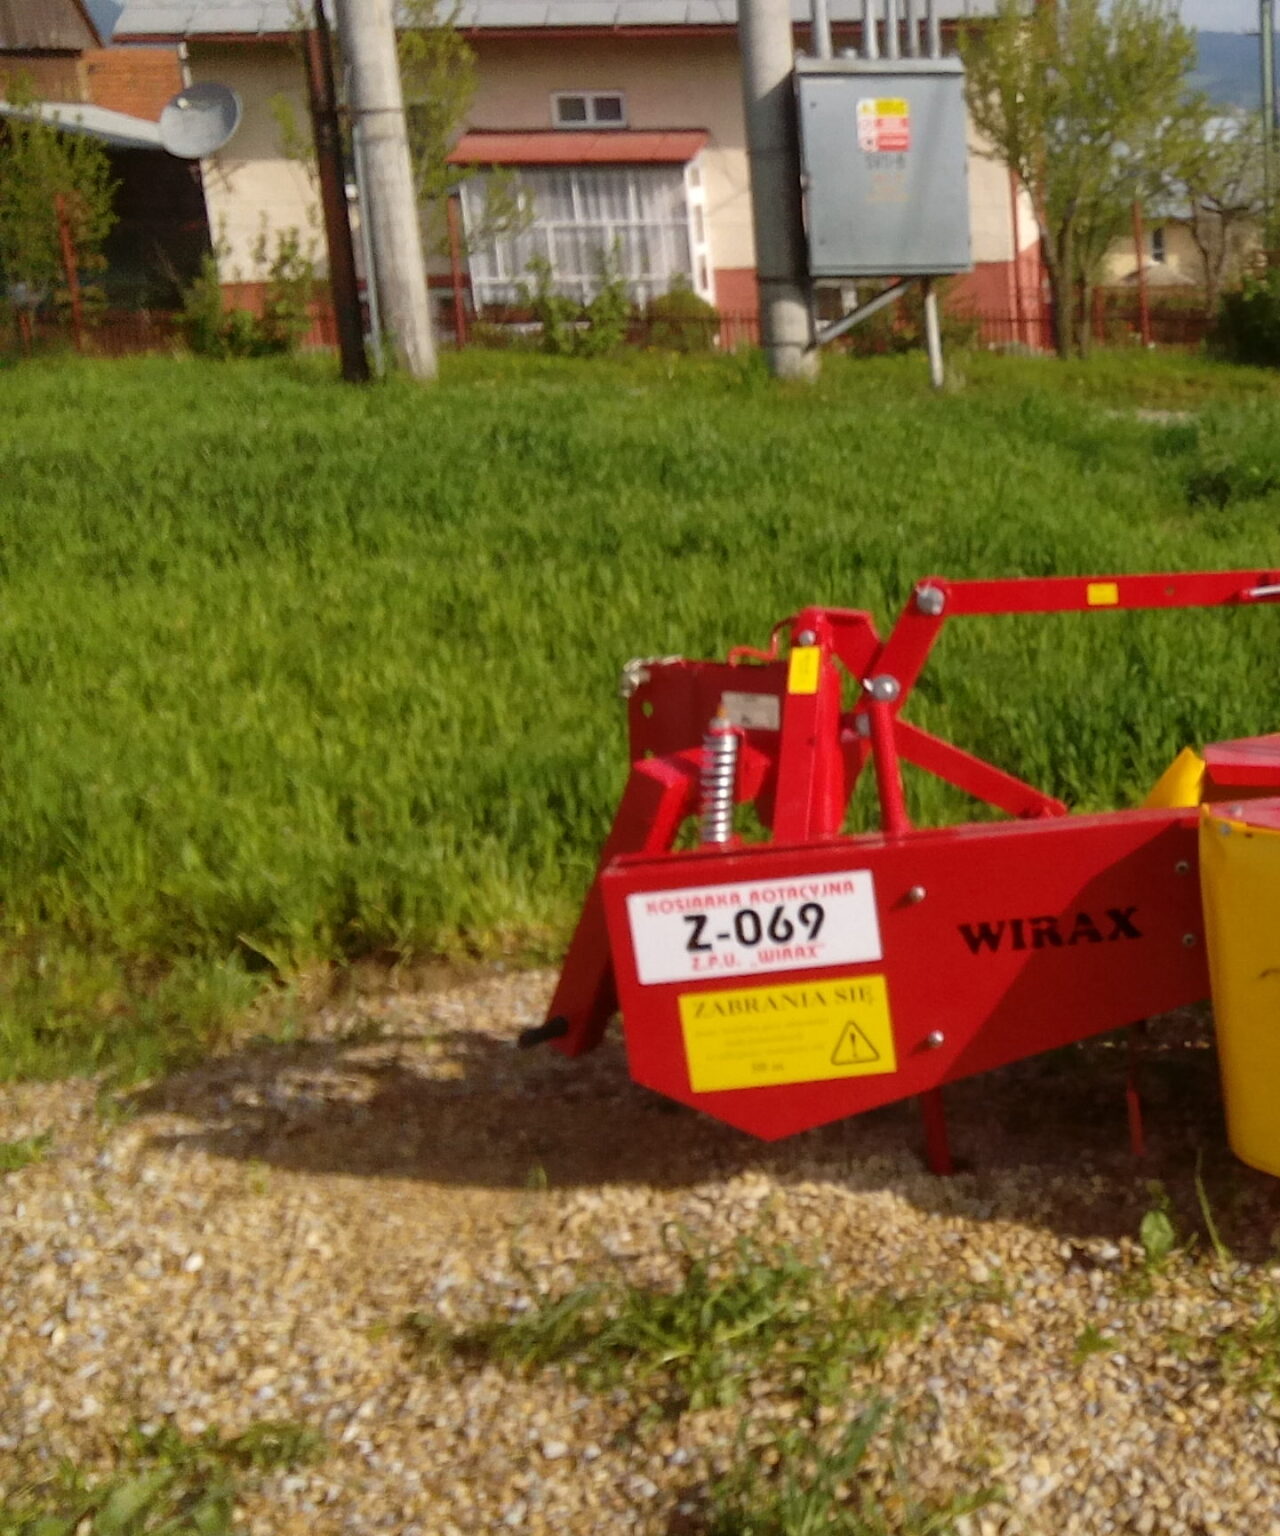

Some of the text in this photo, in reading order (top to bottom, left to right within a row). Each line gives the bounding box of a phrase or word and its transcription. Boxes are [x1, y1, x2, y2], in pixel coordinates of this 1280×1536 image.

[645, 880, 856, 915] KOSIARKA ROTACYJNA
[684, 902, 826, 953] Z-069
[957, 907, 1142, 955] WIRAX
[693, 994, 828, 1019] ZABRANIA
